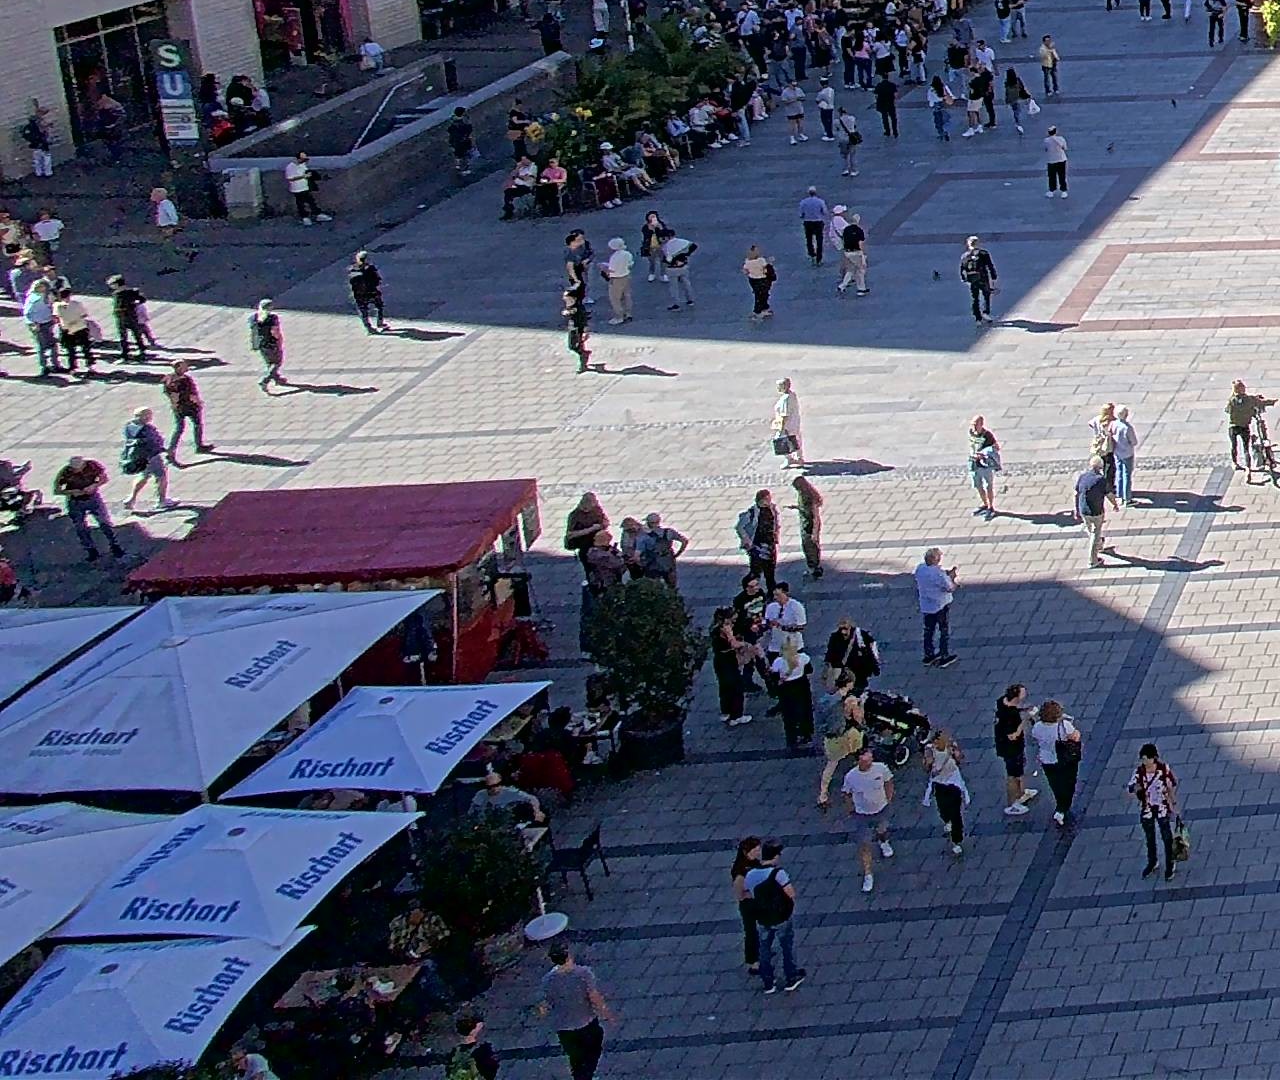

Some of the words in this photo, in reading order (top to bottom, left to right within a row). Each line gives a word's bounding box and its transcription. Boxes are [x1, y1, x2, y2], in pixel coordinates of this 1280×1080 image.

[159, 44, 181, 68] S
[163, 73, 184, 96] U
[225, 639, 298, 690] Rischart
[36, 727, 139, 747] Rischart
[425, 699, 498, 755] Rischart
[289, 756, 395, 780] Rischart
[276, 831, 363, 900] Rischart
[120, 896, 240, 922] Rischart
[164, 956, 251, 1035] Rischart
[0, 1041, 128, 1076] Rischart
